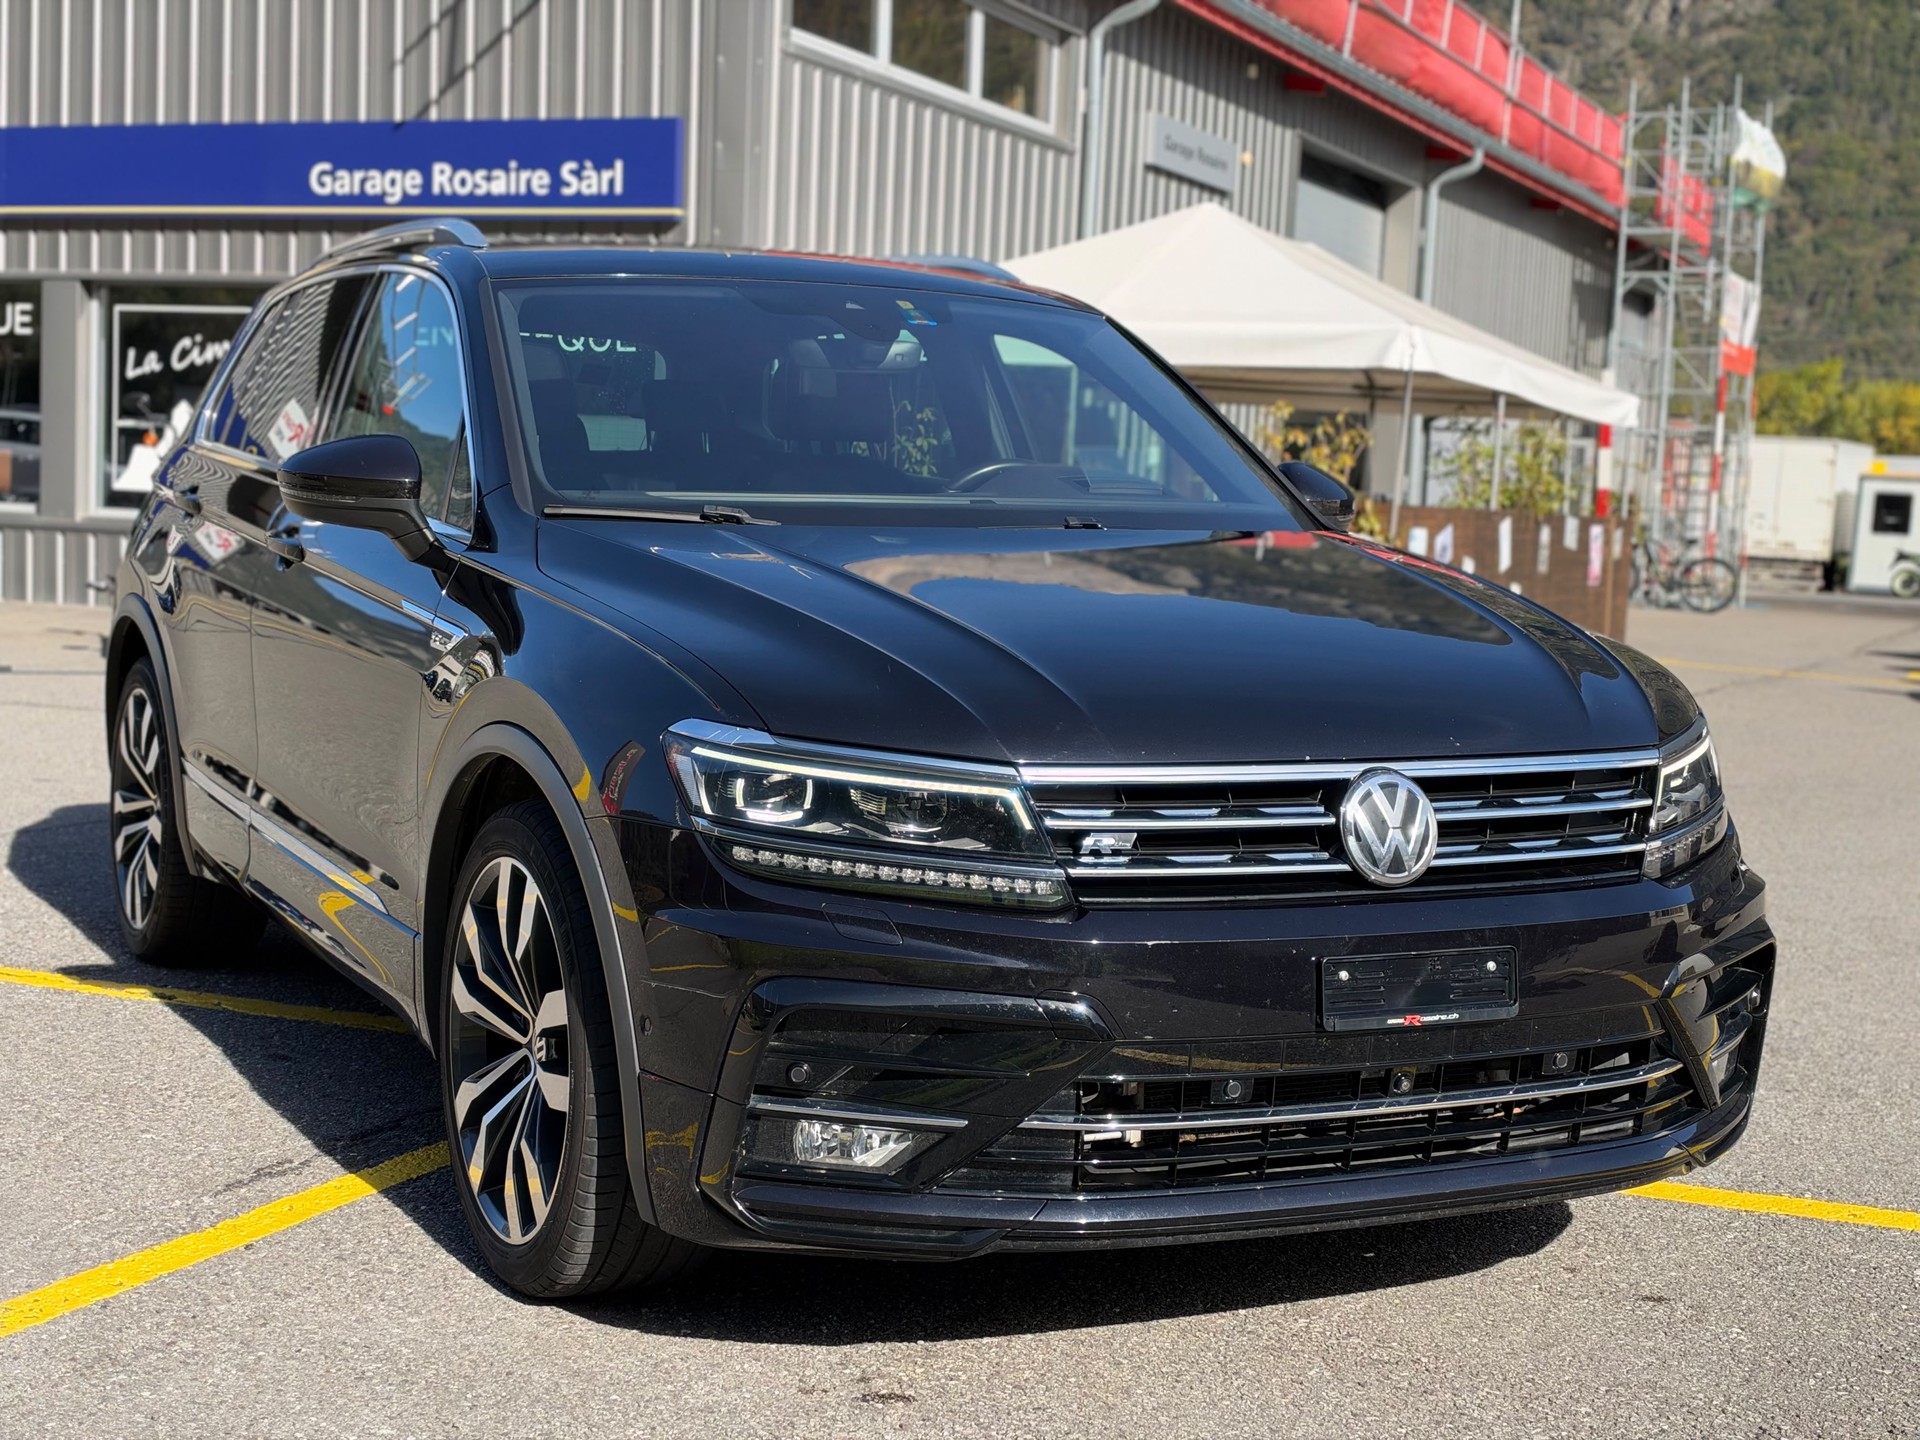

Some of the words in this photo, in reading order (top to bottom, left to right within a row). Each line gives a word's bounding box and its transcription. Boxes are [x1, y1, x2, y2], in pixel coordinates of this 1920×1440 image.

[308, 161, 423, 204] Garage
[431, 159, 550, 196] Rosaire
[559, 158, 624, 196] Sàrl
[125, 346, 164, 380] La
